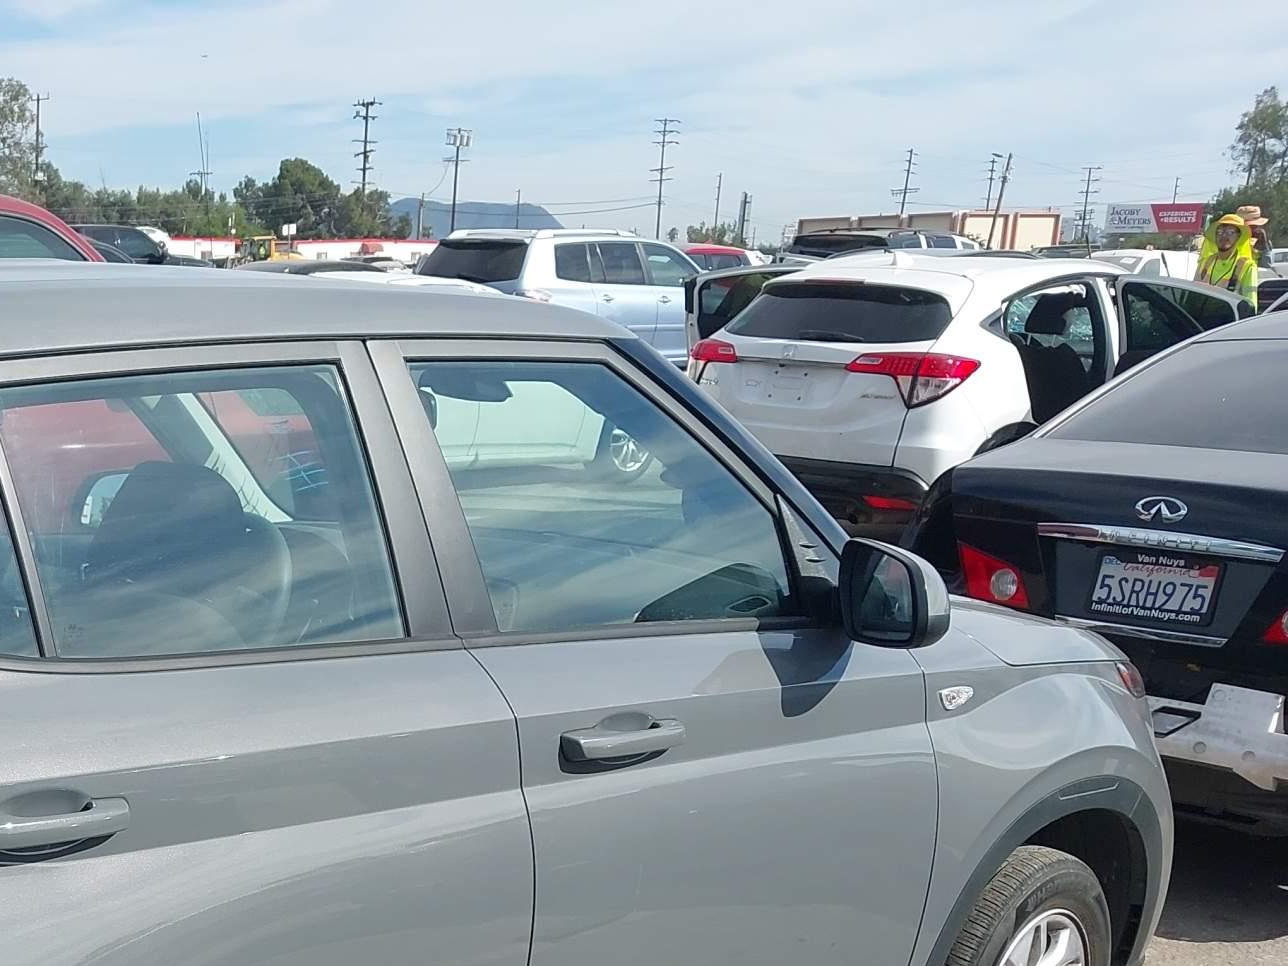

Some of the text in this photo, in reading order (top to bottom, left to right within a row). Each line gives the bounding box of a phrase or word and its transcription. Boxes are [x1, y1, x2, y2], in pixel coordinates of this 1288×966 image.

[1110, 207, 1141, 216] JACOBY
[1137, 554, 1185, 567] Van Nuys
[1097, 574, 1208, 613] 5SRH975
[1091, 602, 1200, 622] InfinitiofVanNuys.com
